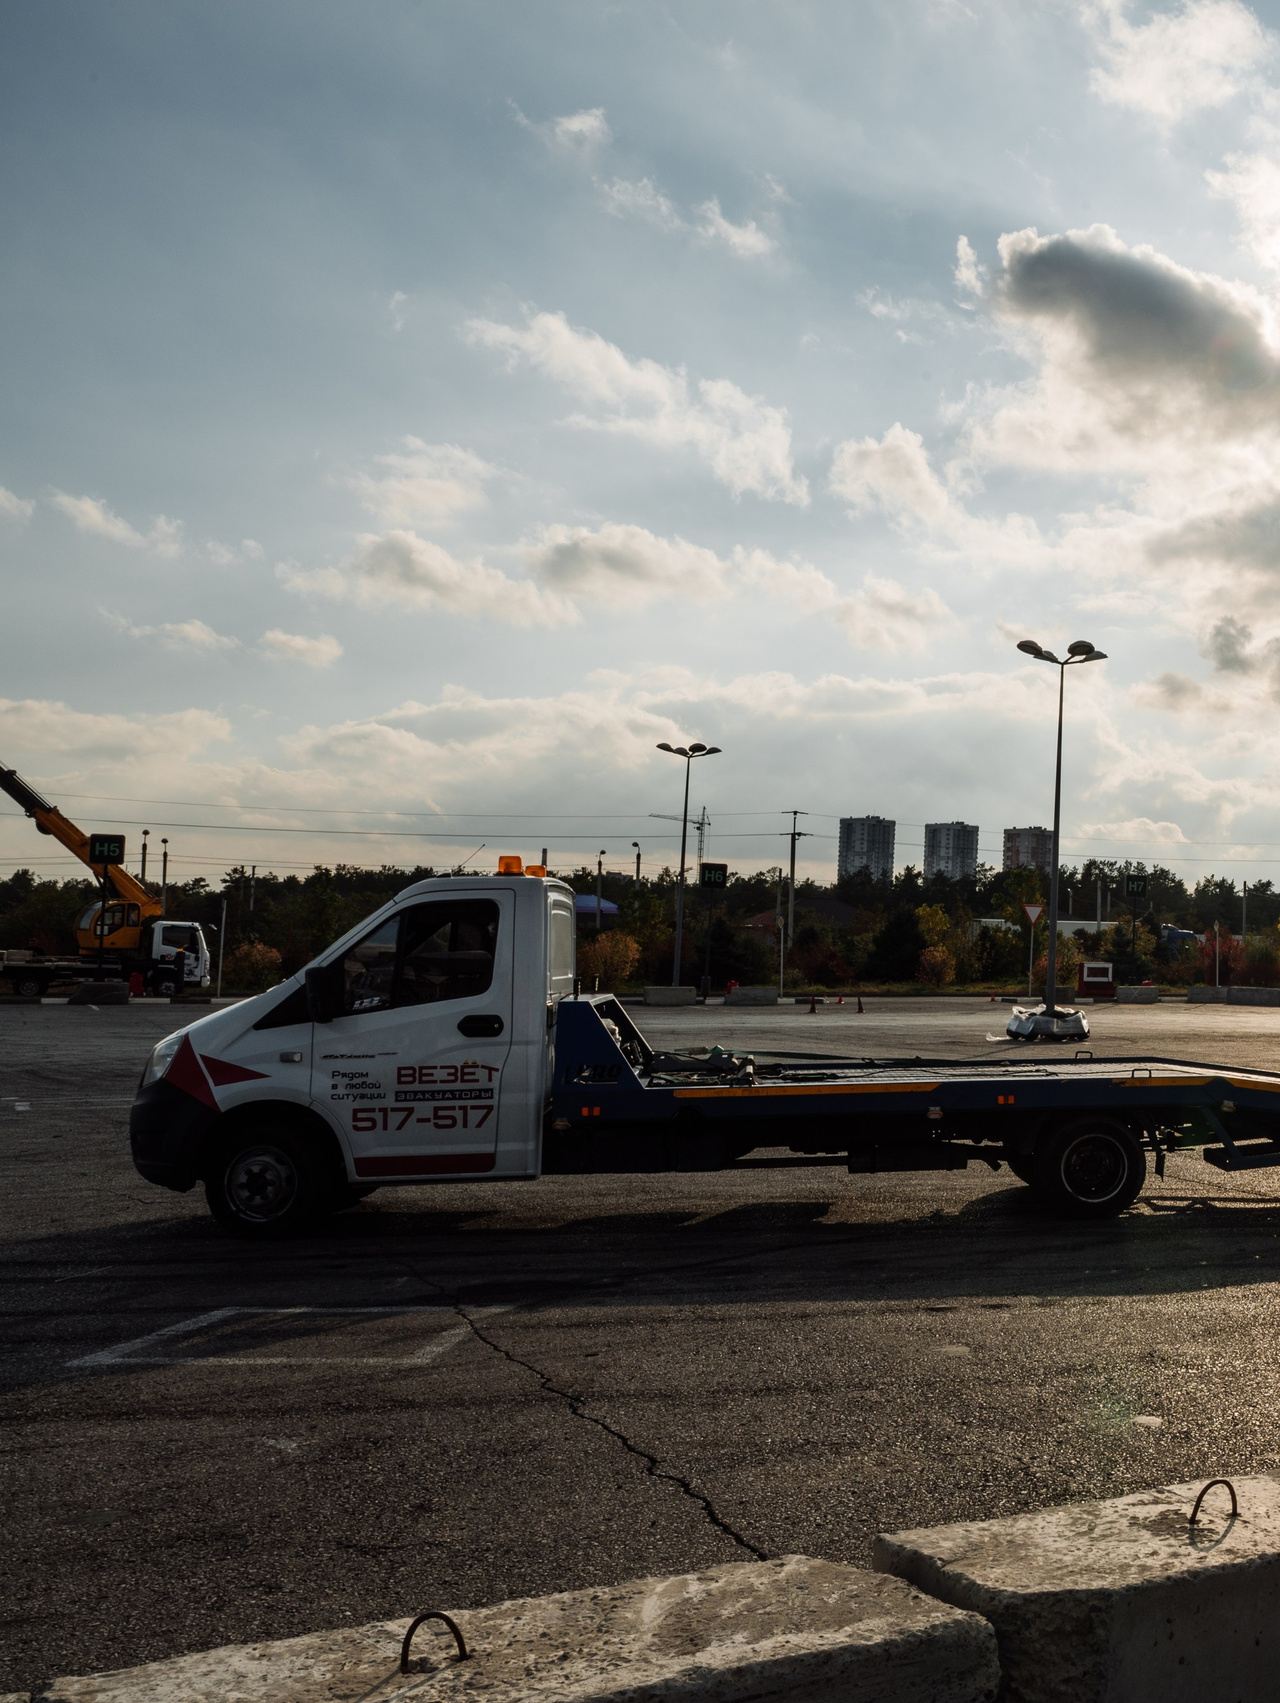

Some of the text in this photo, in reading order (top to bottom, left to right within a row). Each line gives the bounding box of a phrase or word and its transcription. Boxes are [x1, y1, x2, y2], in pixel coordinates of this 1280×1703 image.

[94, 842, 120, 856] H5
[704, 870, 724, 882] H6
[1128, 880, 1145, 892] H7
[331, 1070, 369, 1080] Рядом
[397, 1060, 500, 1085] ВЕЗЁТ
[345, 1081, 381, 1090] любой
[331, 1093, 386, 1101] ситуации
[397, 1090, 493, 1100] ЭВАКУАТОРЫ
[352, 1105, 494, 1132] 517-517
